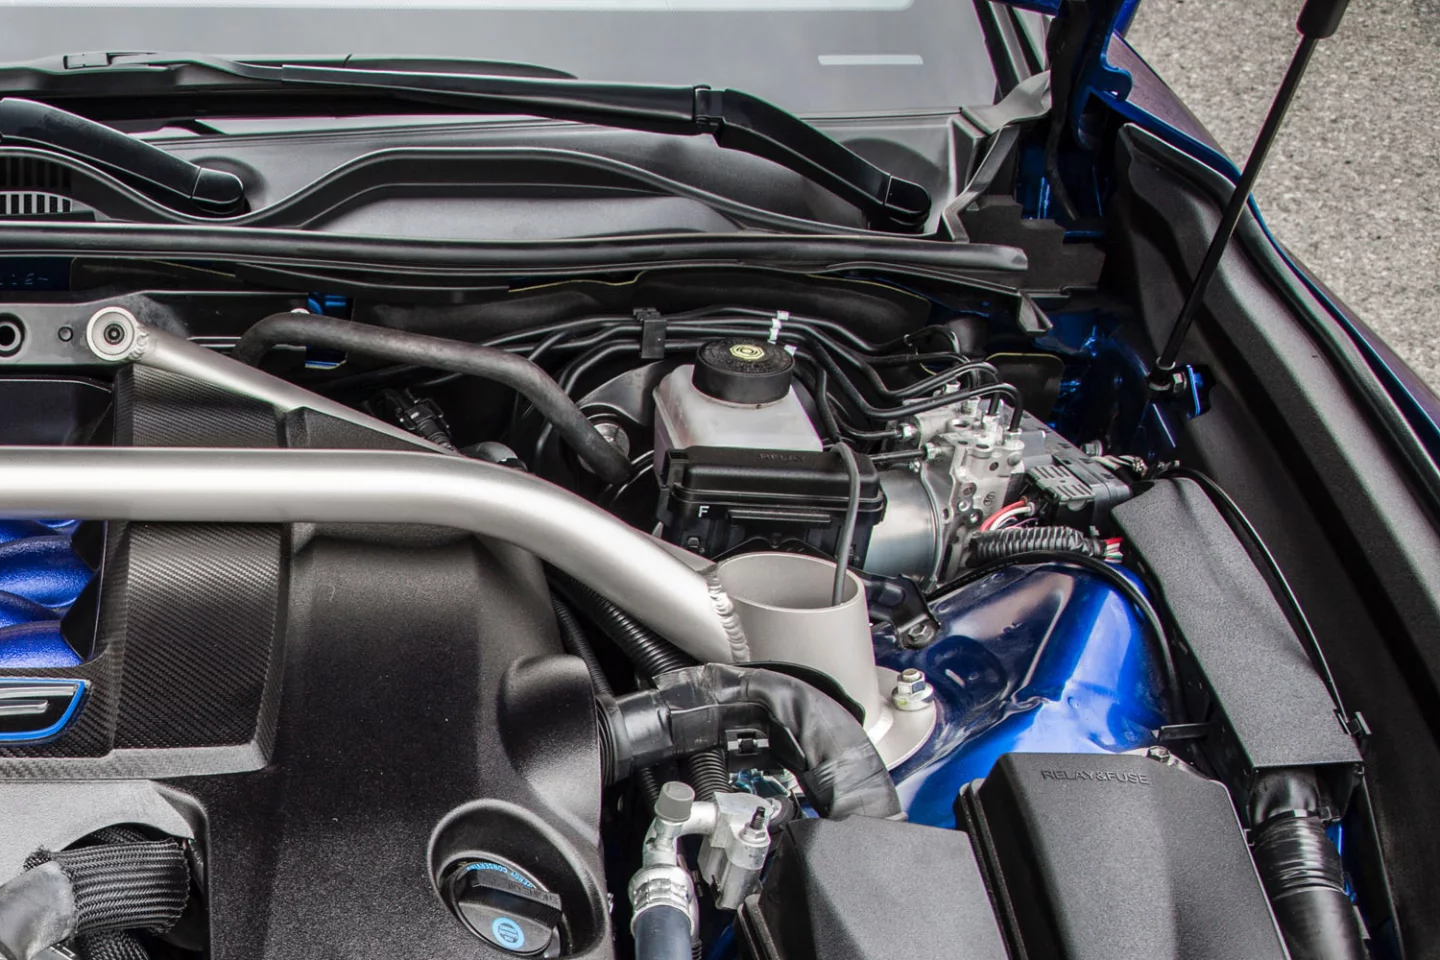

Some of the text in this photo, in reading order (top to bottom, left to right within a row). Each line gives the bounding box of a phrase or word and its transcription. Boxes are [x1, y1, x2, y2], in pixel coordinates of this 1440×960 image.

[758, 452, 807, 462] RELAY
[697, 505, 710, 518] F
[1041, 769, 1151, 786] RELAY&FUSE
